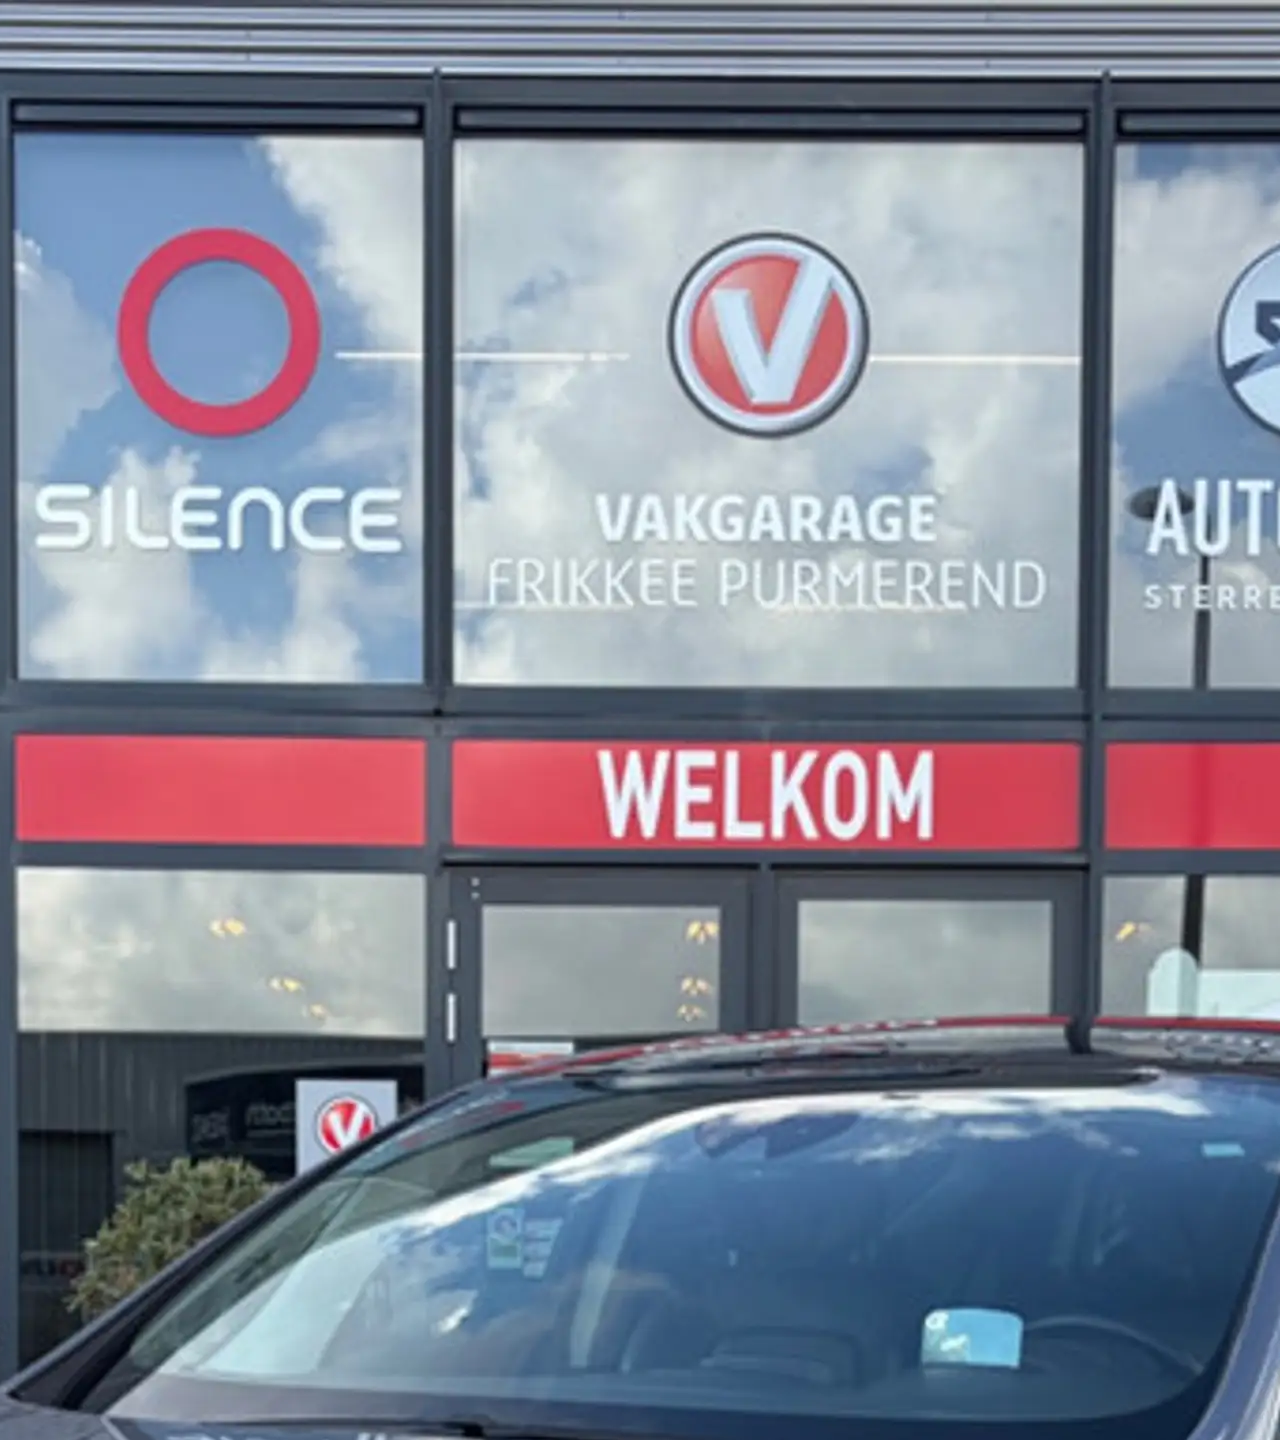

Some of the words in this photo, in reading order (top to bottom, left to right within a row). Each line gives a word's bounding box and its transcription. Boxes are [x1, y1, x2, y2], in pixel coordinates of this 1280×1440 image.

[35, 483, 404, 553] SILENCE
[596, 494, 938, 543] VAKGARAGE
[489, 558, 698, 608] FRIKKEE
[720, 559, 1047, 609] PURMEREND
[598, 749, 934, 841] WELKOM
